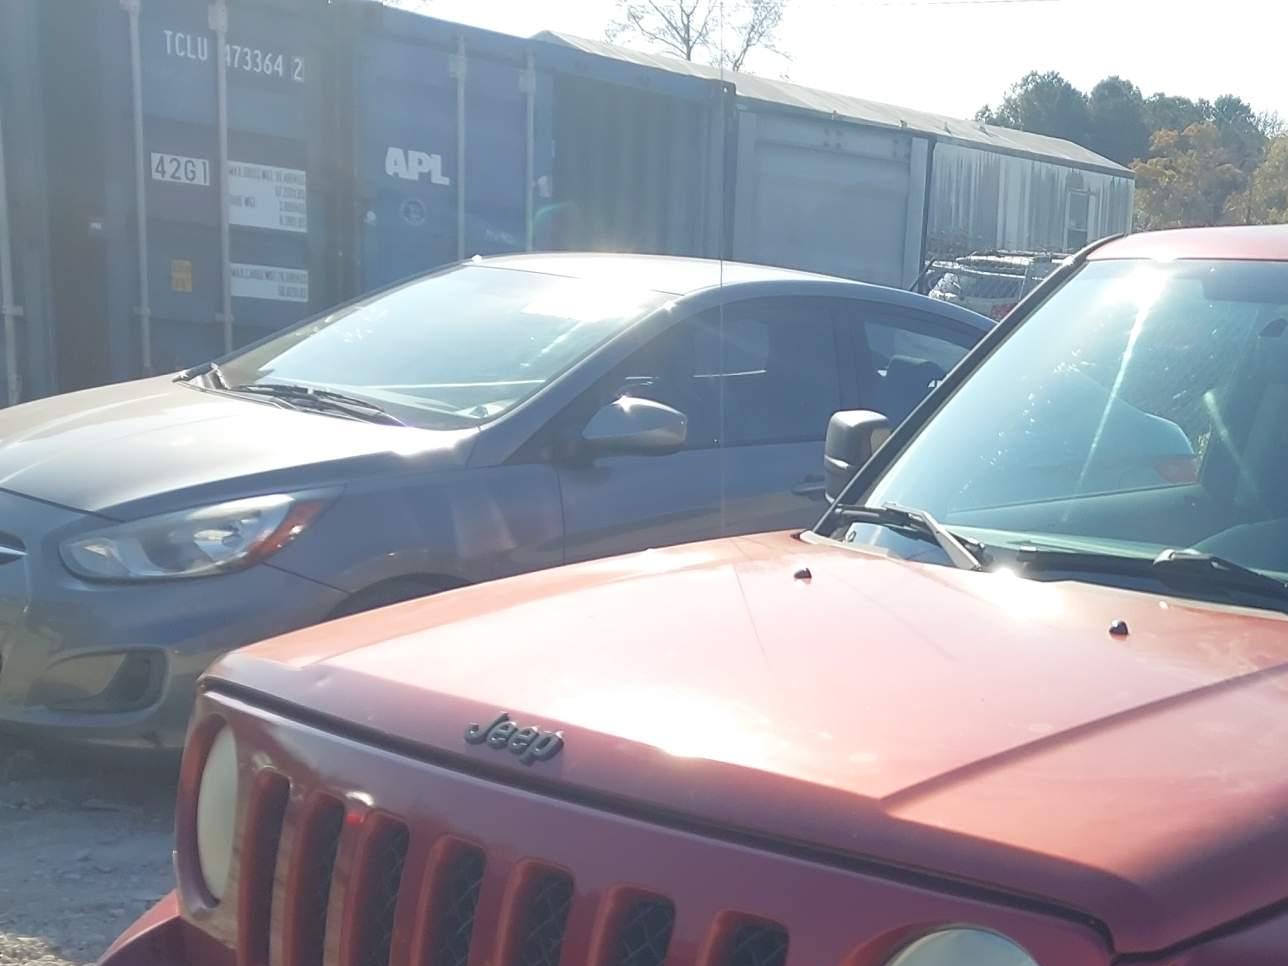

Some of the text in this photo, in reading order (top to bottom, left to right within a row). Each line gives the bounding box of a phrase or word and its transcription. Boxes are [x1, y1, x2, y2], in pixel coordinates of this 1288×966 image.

[164, 30, 208, 61] TCLU
[293, 57, 305, 82] 2
[154, 155, 208, 185] 42G1
[385, 147, 450, 185] APL
[463, 711, 565, 766] Jeep
